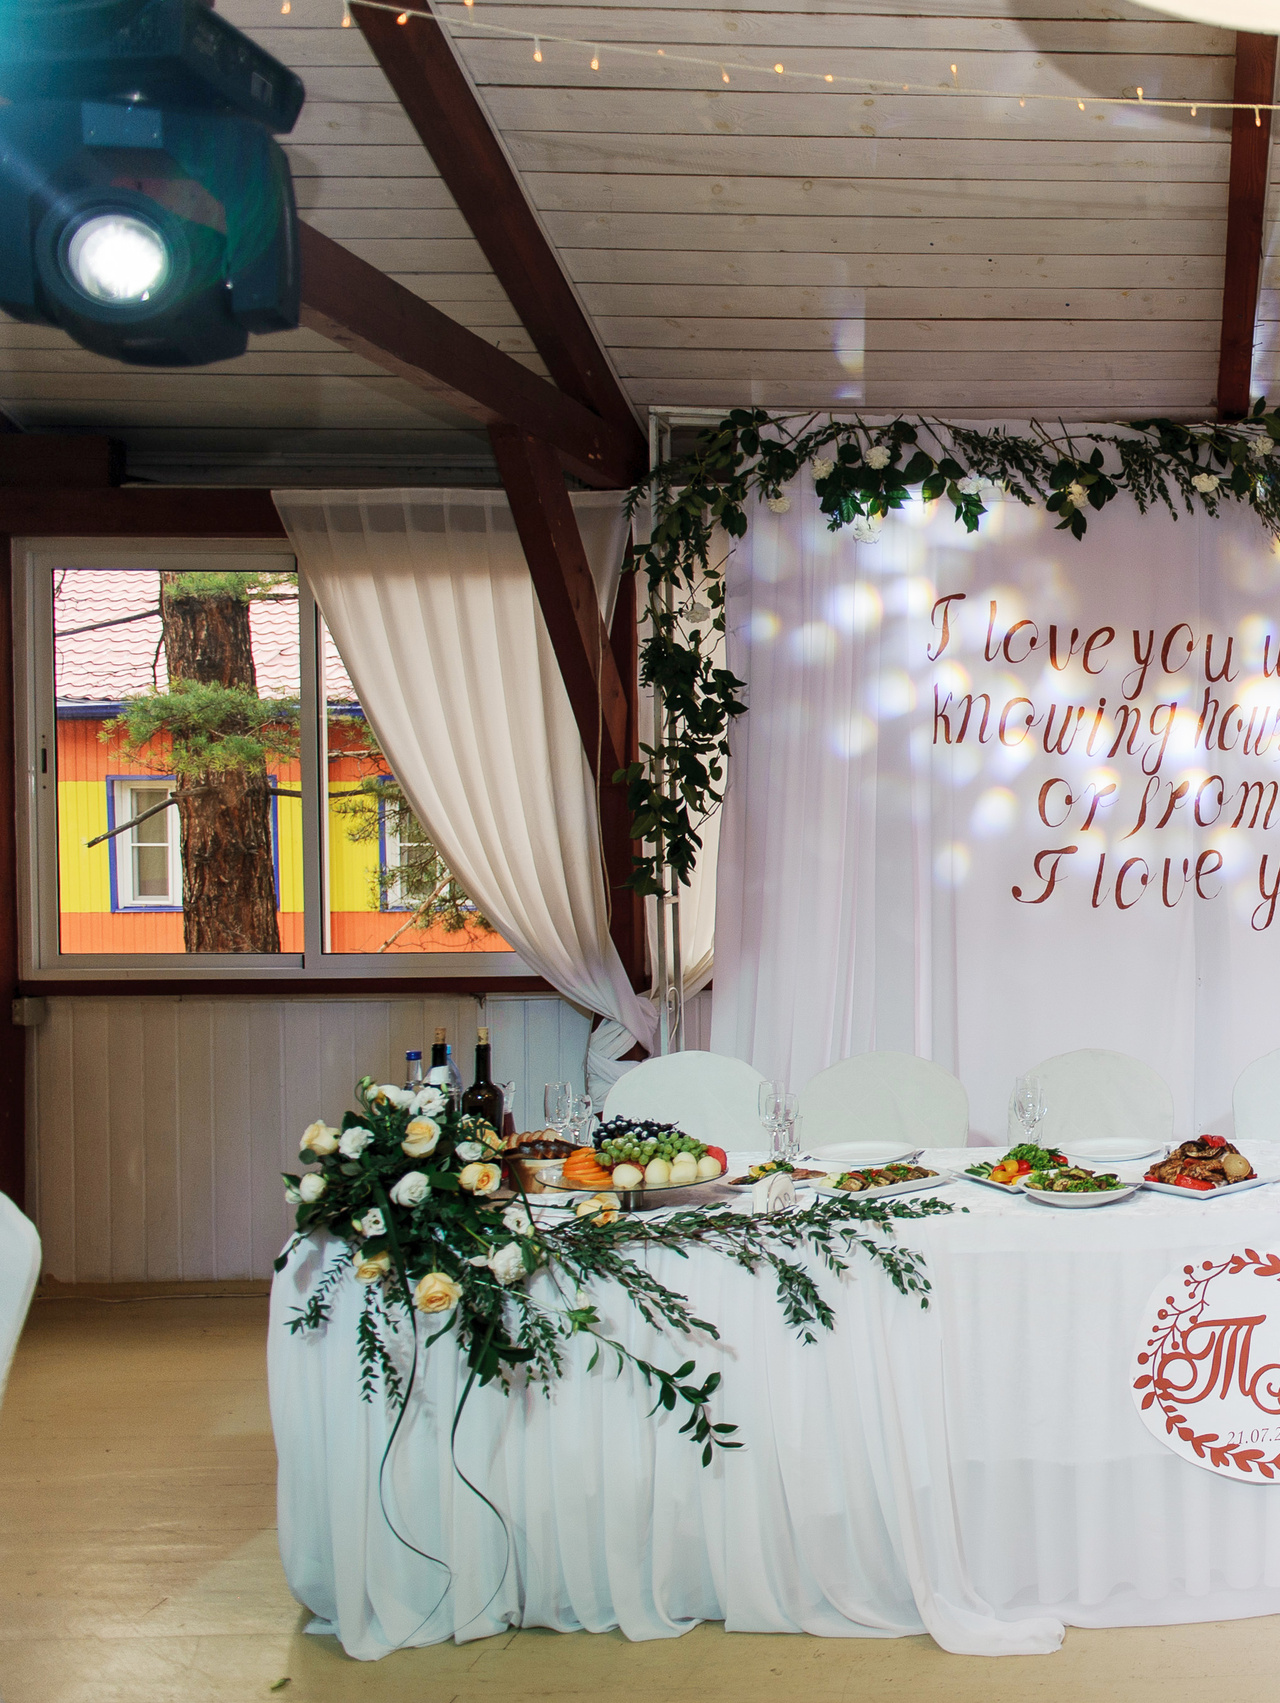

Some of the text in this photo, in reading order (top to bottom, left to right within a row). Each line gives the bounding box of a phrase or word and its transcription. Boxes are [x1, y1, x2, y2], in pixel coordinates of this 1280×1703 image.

[927, 593, 967, 662] I
[984, 600, 1115, 675] love
[1121, 623, 1239, 701] you
[932, 682, 1180, 776] knowing
[1037, 778, 1120, 831] or
[1120, 775, 1280, 841] from
[1011, 845, 1079, 904] I
[1091, 849, 1224, 910] love
